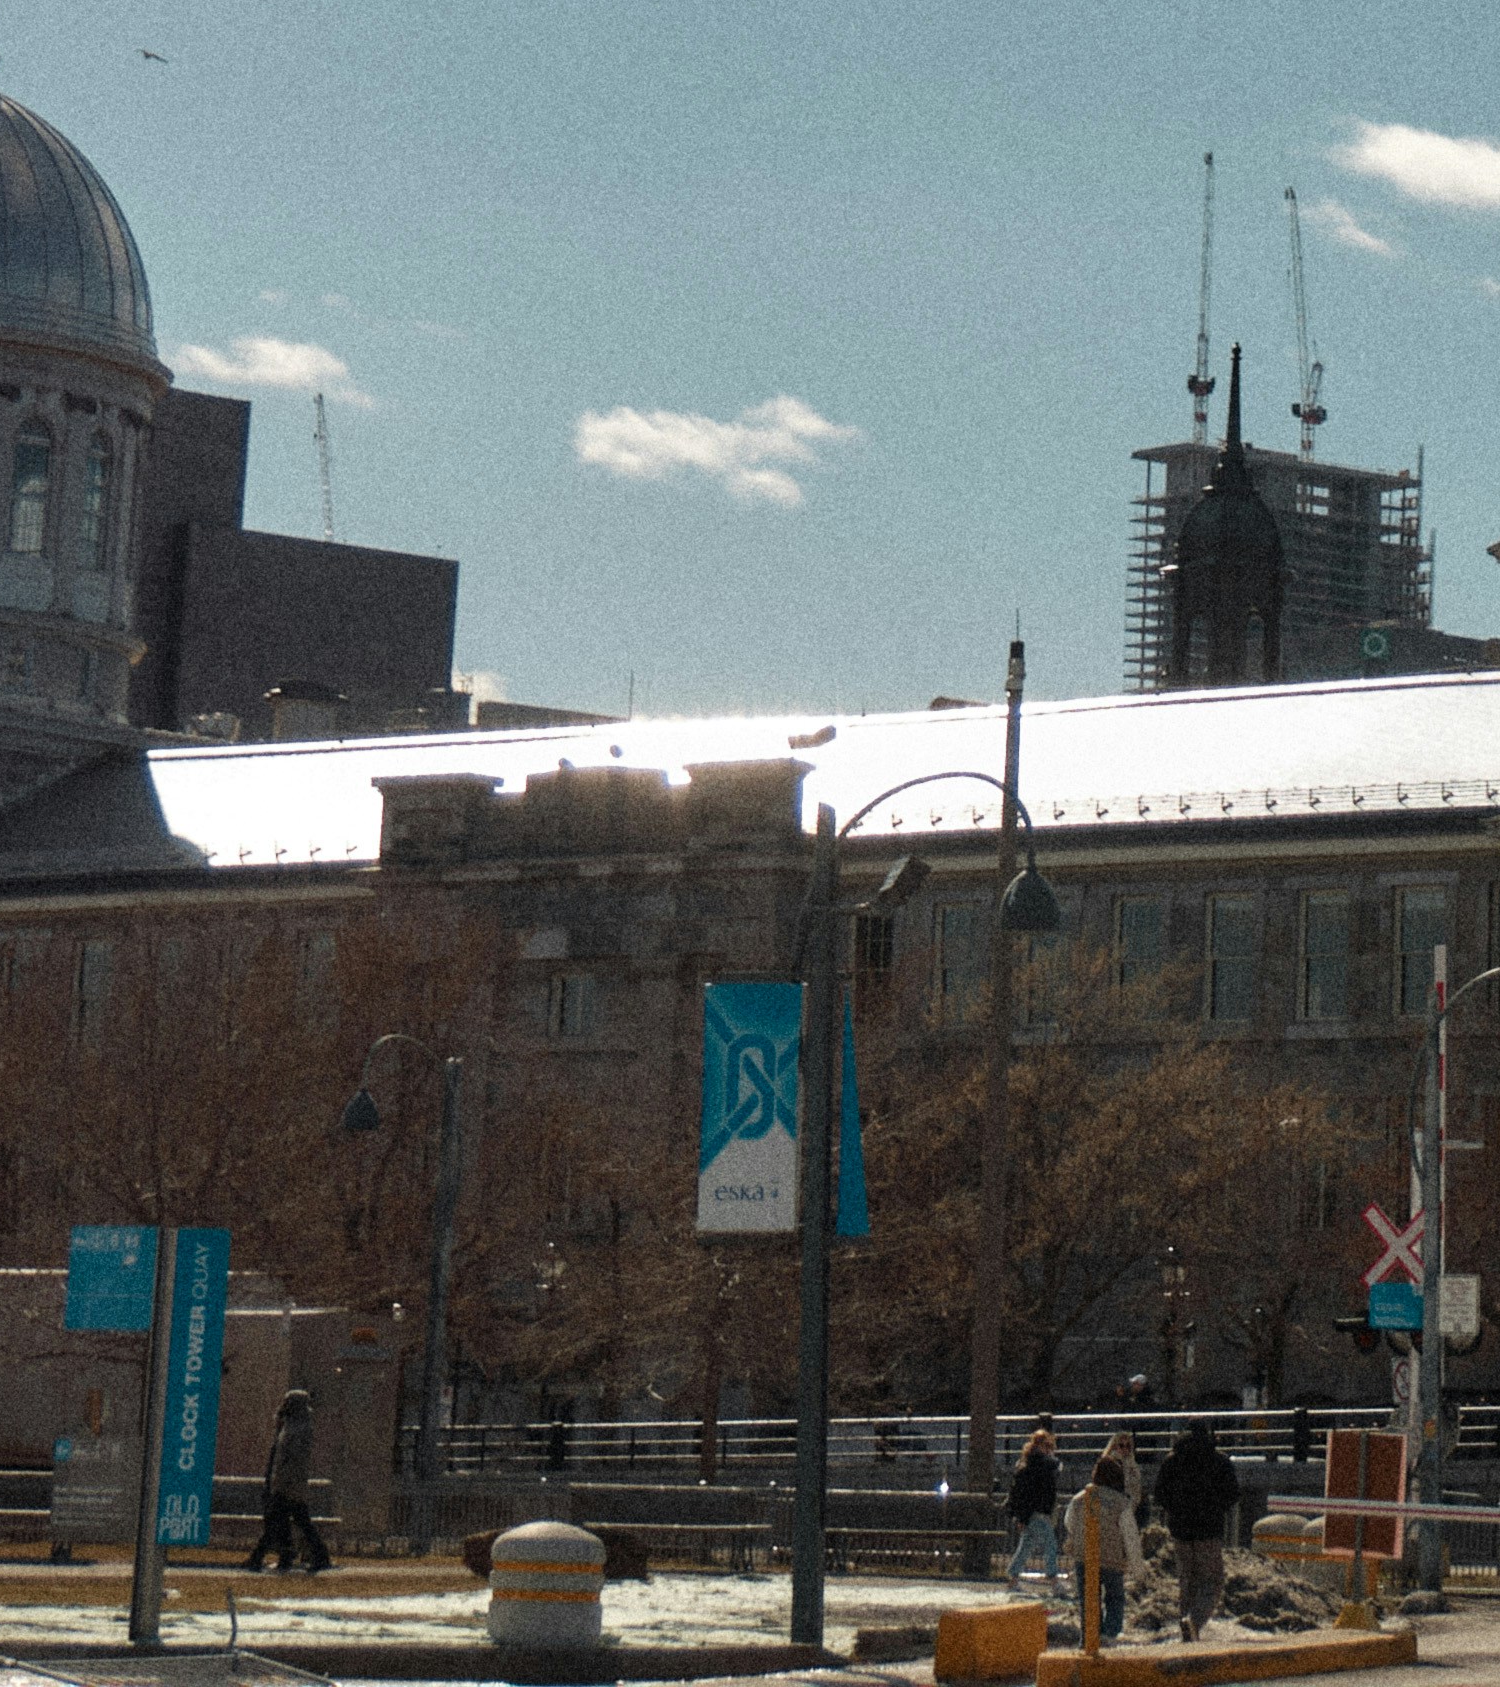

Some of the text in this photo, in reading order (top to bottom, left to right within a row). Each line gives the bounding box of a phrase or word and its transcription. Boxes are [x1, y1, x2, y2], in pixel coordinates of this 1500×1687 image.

[714, 1183, 765, 1202] eska
[177, 1241, 212, 1472] CLOCK TOWER QUAY
